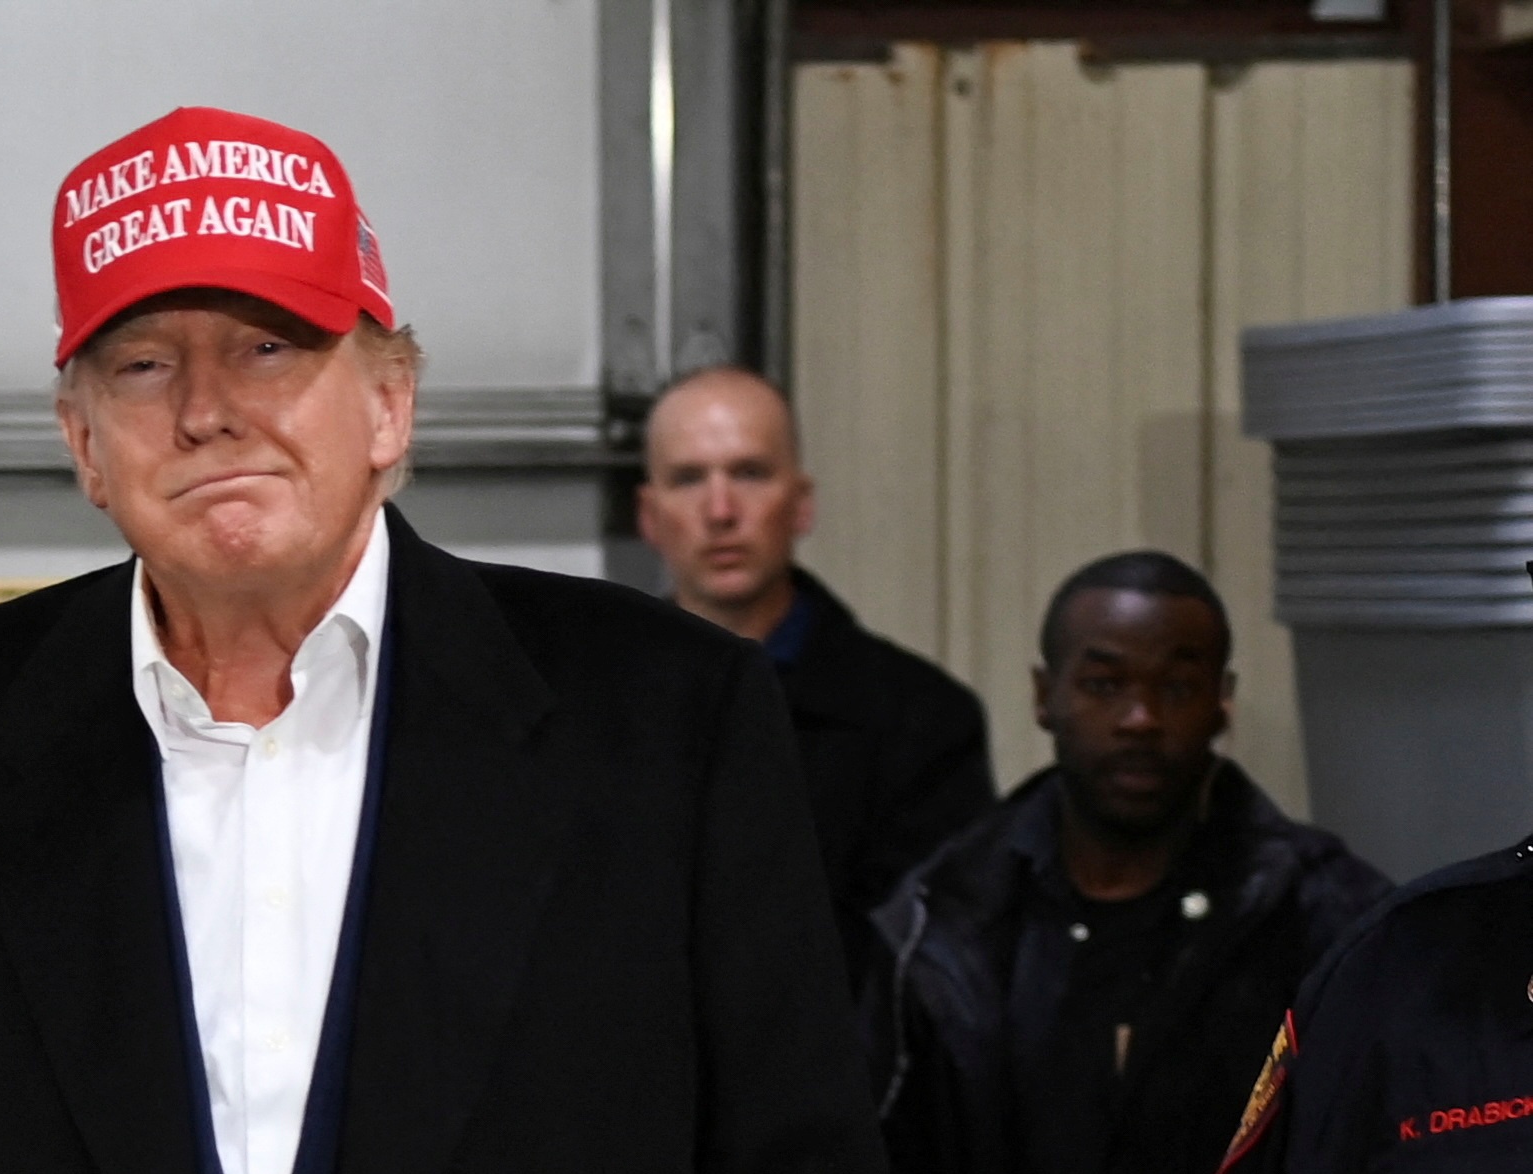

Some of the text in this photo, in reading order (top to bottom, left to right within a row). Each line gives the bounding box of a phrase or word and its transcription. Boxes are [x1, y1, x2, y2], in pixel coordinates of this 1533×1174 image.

[65, 140, 335, 227] MAKE AMERICA
[83, 196, 316, 275] GREAT AGAIN
[1399, 1117, 1422, 1141] K.
